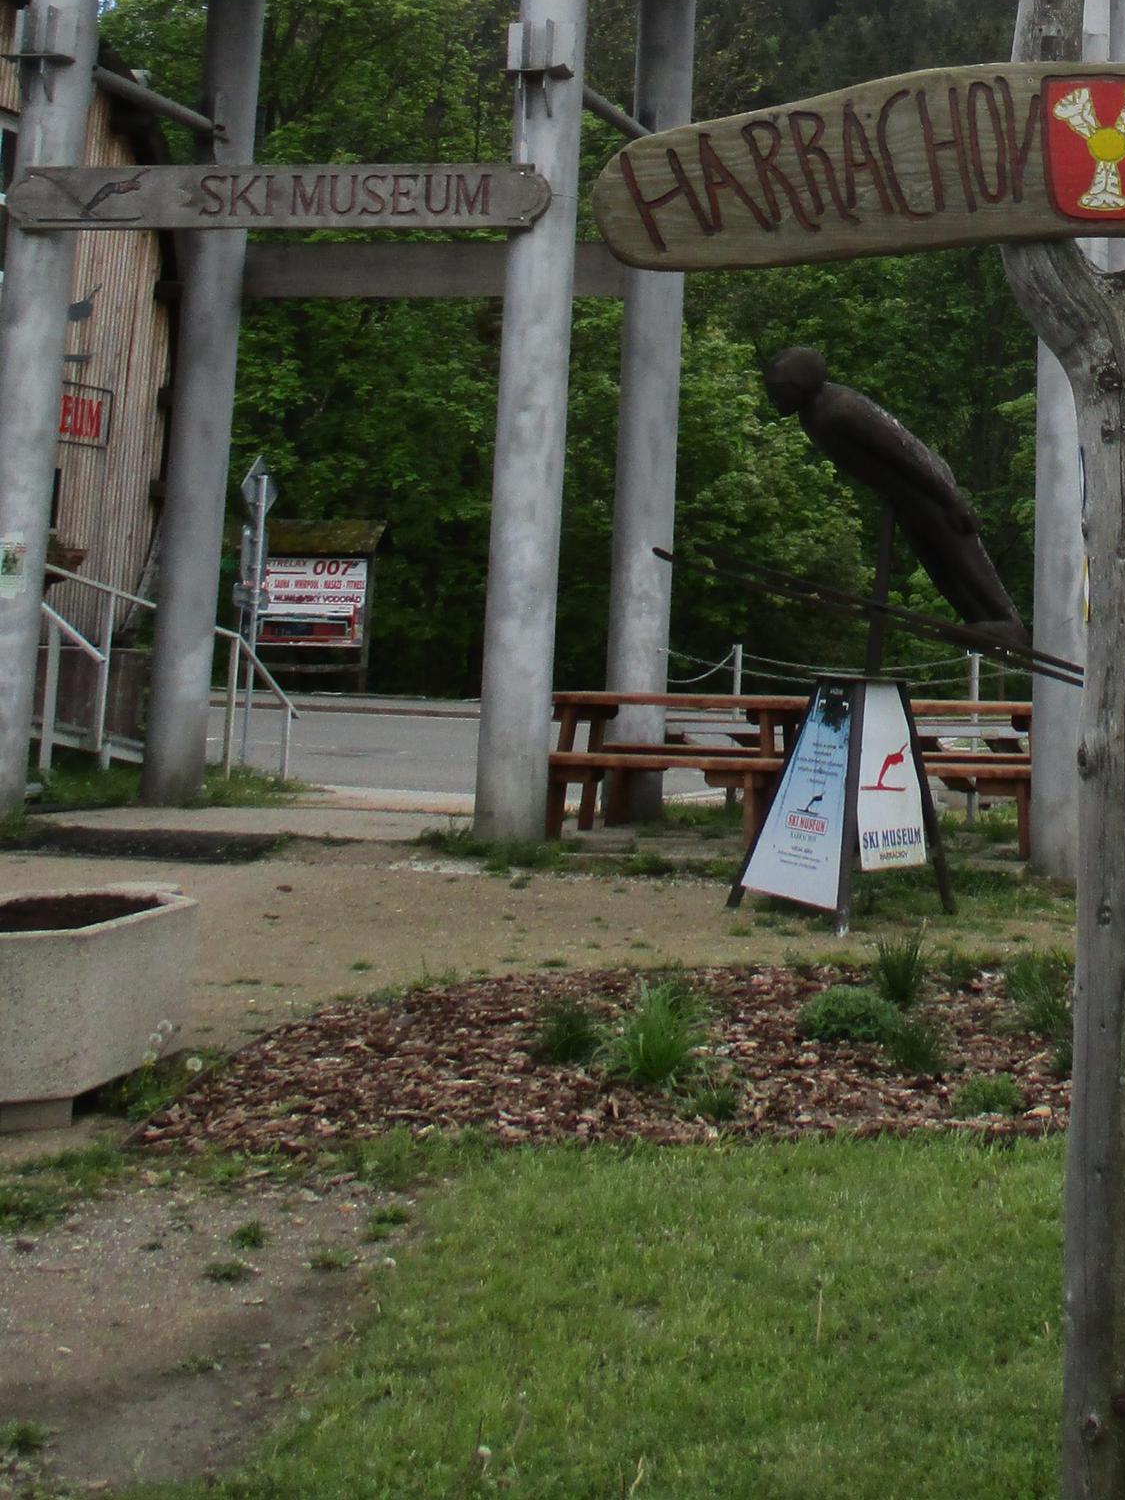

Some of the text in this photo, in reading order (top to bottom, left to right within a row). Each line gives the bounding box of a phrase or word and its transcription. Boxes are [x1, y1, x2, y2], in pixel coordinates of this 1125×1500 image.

[619, 74, 1042, 253] HARRACHOV
[200, 173, 494, 217] SKI MUSEUM
[312, 560, 353, 576] 007
[863, 826, 921, 850] SKI MUSEUM
